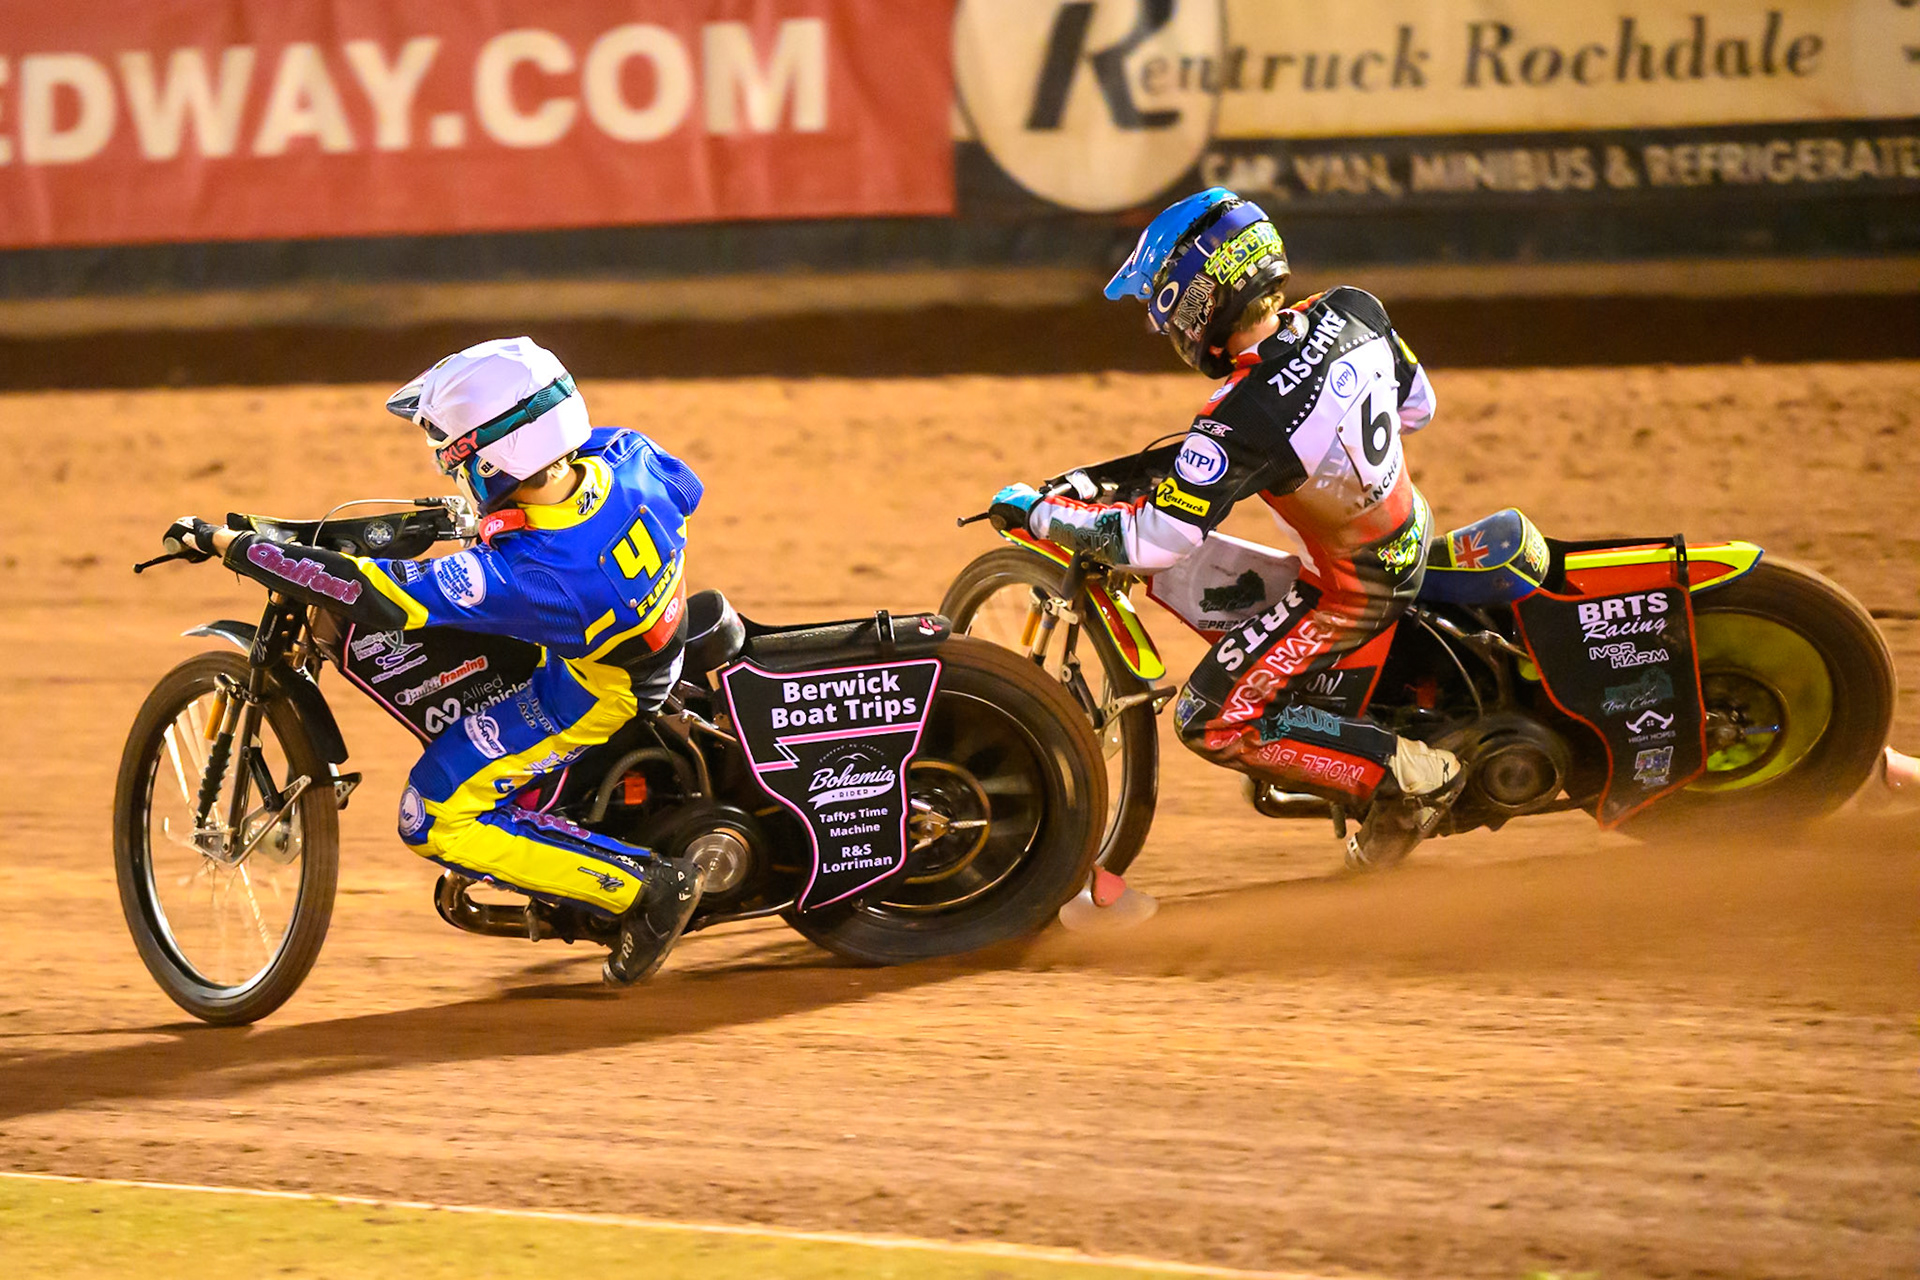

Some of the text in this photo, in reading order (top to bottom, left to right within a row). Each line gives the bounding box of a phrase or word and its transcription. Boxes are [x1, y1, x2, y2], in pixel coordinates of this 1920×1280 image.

[1463, 11, 1824, 88] Rochdale
[0, 18, 829, 167] DWAY.COM
[1411, 146, 1596, 192] MINIBUS
[1604, 144, 1639, 187] &
[1335, 368, 1353, 391] ATPI
[1361, 391, 1392, 467] 6
[1181, 448, 1215, 472] ATPI
[1157, 483, 1205, 513] Rentruck
[611, 517, 663, 580] 4
[247, 543, 363, 605] Chalfont
[636, 558, 677, 618] FLINT
[1578, 592, 1669, 625] BRTS
[1582, 616, 1668, 643] Racing
[1589, 642, 1636, 660] IVOR
[1611, 648, 1669, 669] HARM
[463, 674, 504, 703] Allied
[782, 670, 900, 703] Berwick
[771, 695, 917, 729] Boat Trips
[808, 762, 896, 793] Bohemia
[839, 789, 869, 798] RIDER
[819, 807, 889, 823] Taffys Time
[830, 823, 881, 837] Machine
[822, 855, 893, 874] Lorriman
[841, 843, 872, 858] R&S
